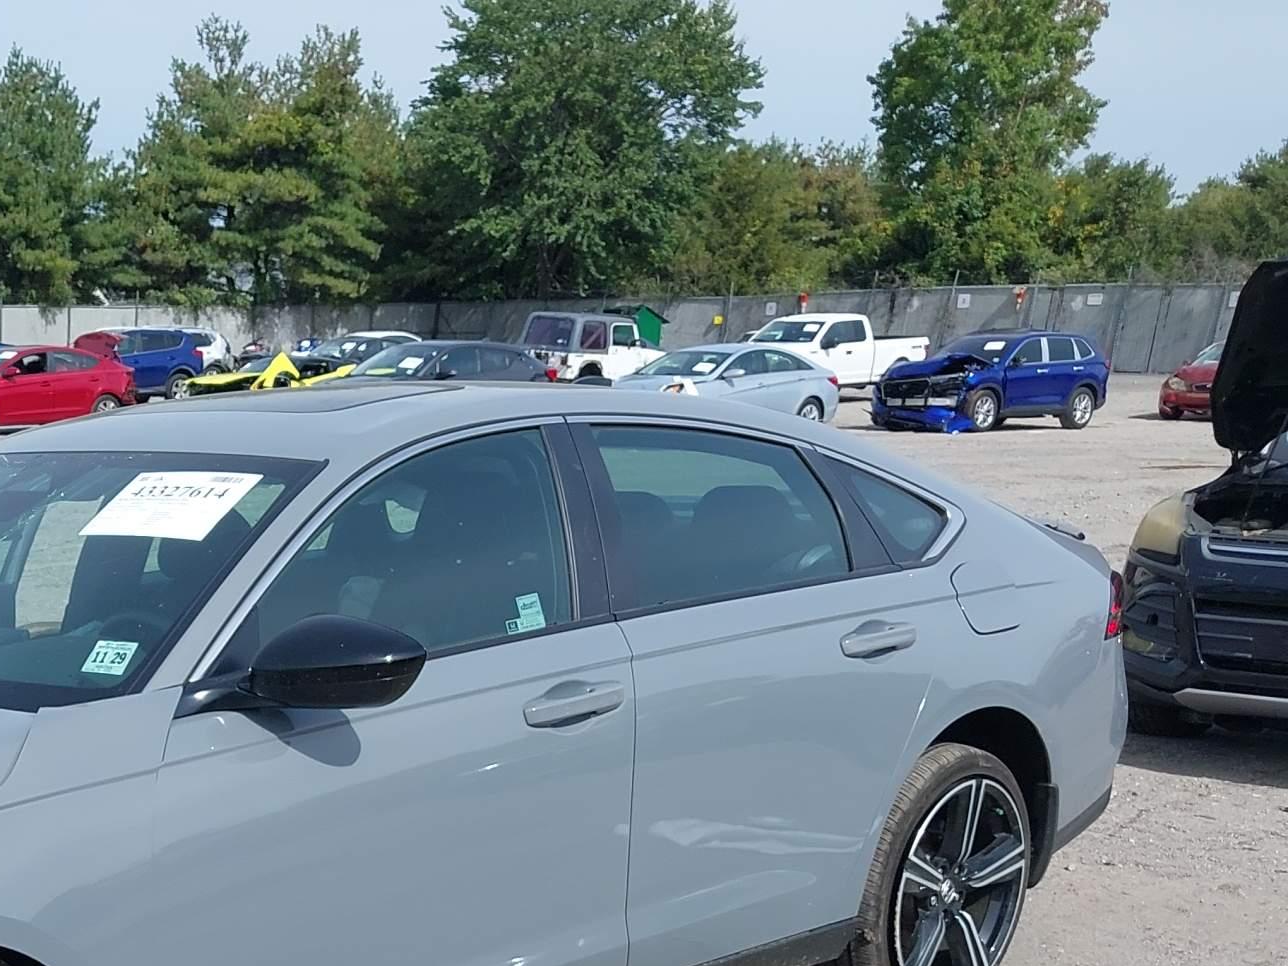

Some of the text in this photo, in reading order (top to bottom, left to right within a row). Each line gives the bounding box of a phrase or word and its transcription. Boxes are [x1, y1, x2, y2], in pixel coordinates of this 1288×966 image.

[131, 486, 231, 498] 43327614
[91, 650, 128, 665] 11 29
